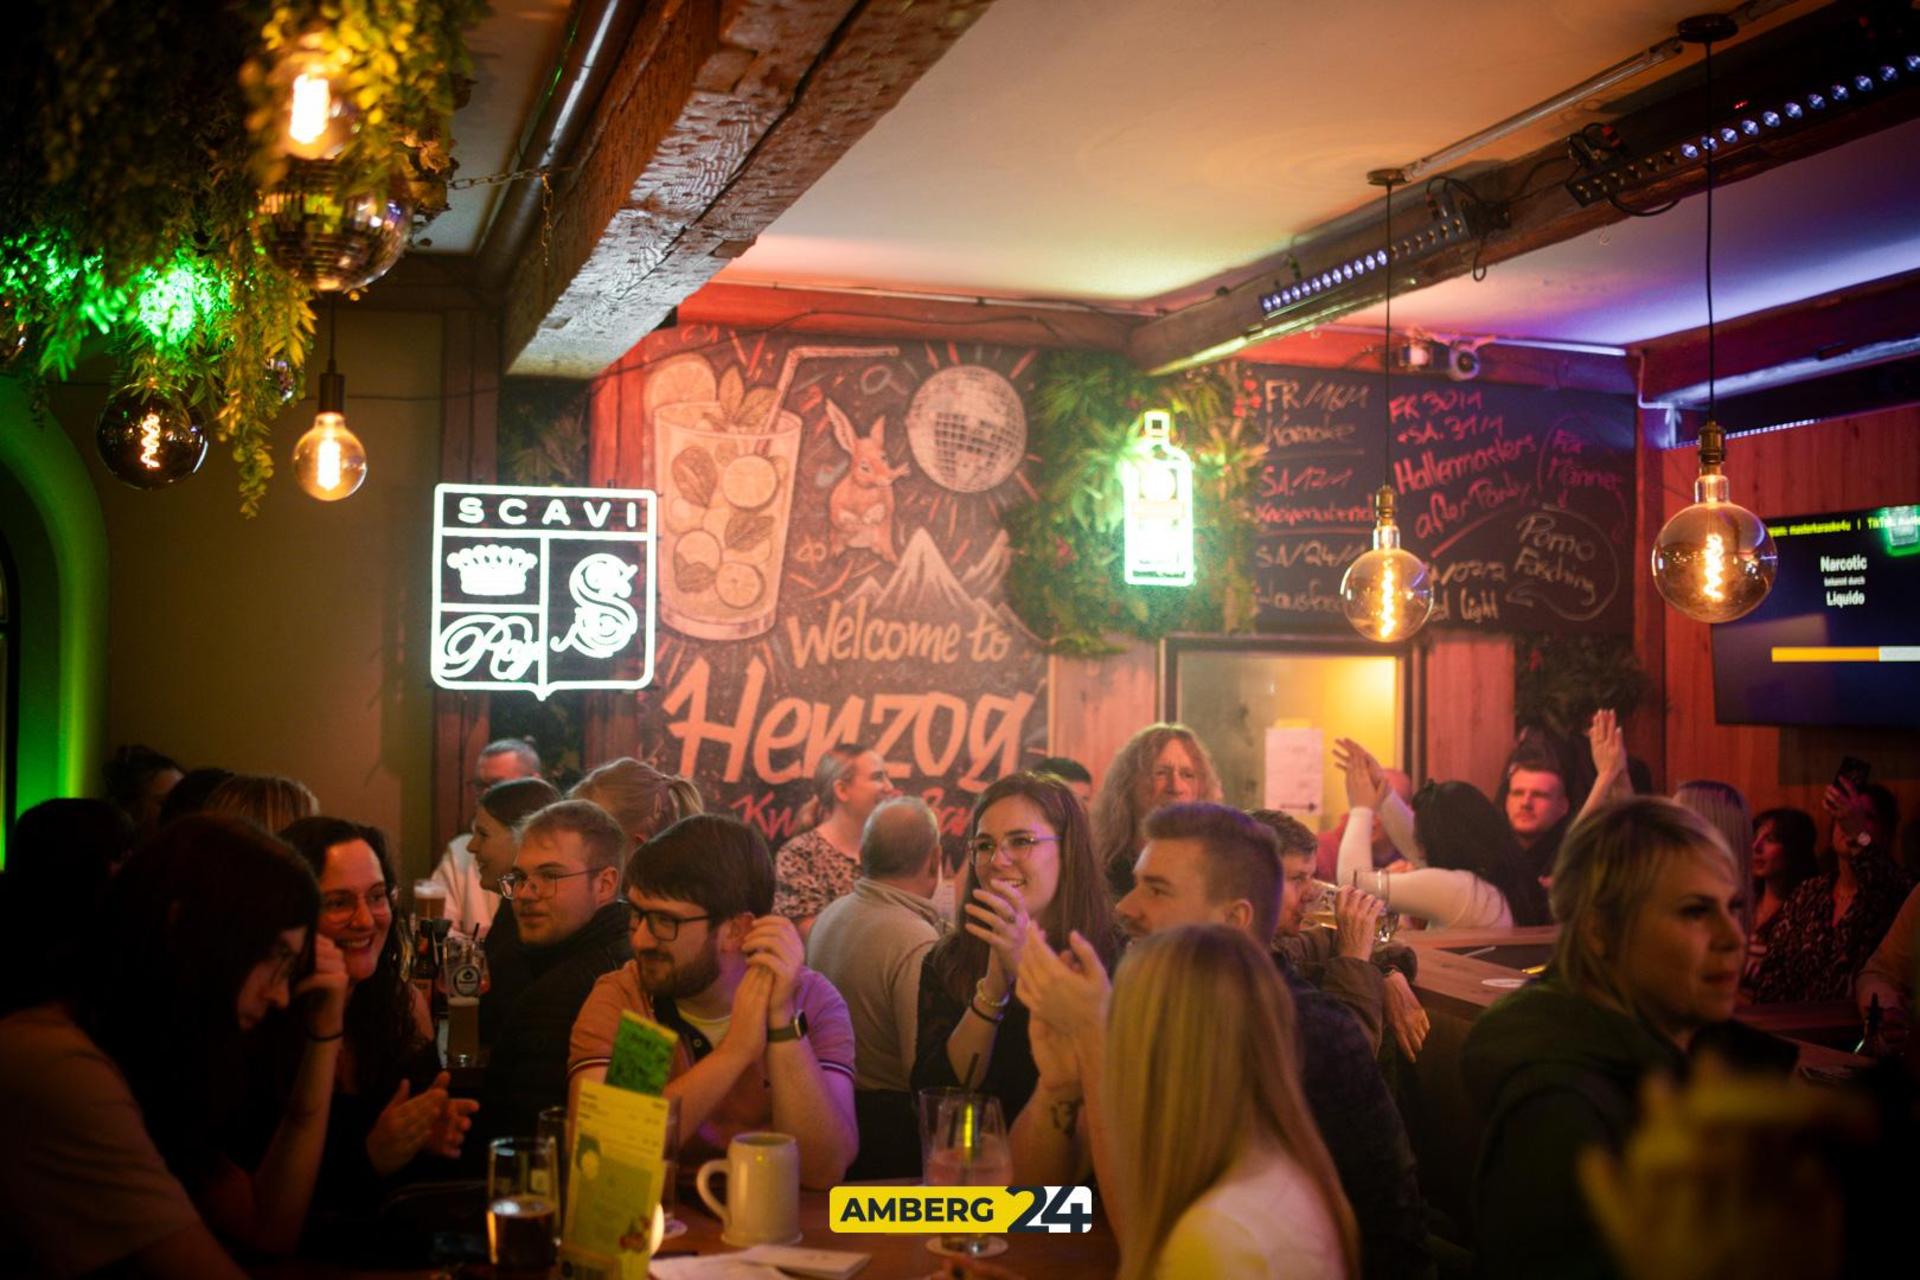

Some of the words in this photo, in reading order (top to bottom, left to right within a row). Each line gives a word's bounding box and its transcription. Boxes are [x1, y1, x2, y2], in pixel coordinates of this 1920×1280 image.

[457, 496, 637, 528] SCAVI
[1820, 554, 1868, 573] Narcotic
[1825, 590, 1866, 608] Liquido
[786, 596, 963, 670] Welcome
[966, 611, 1013, 663] to
[661, 654, 1038, 793] Herzog
